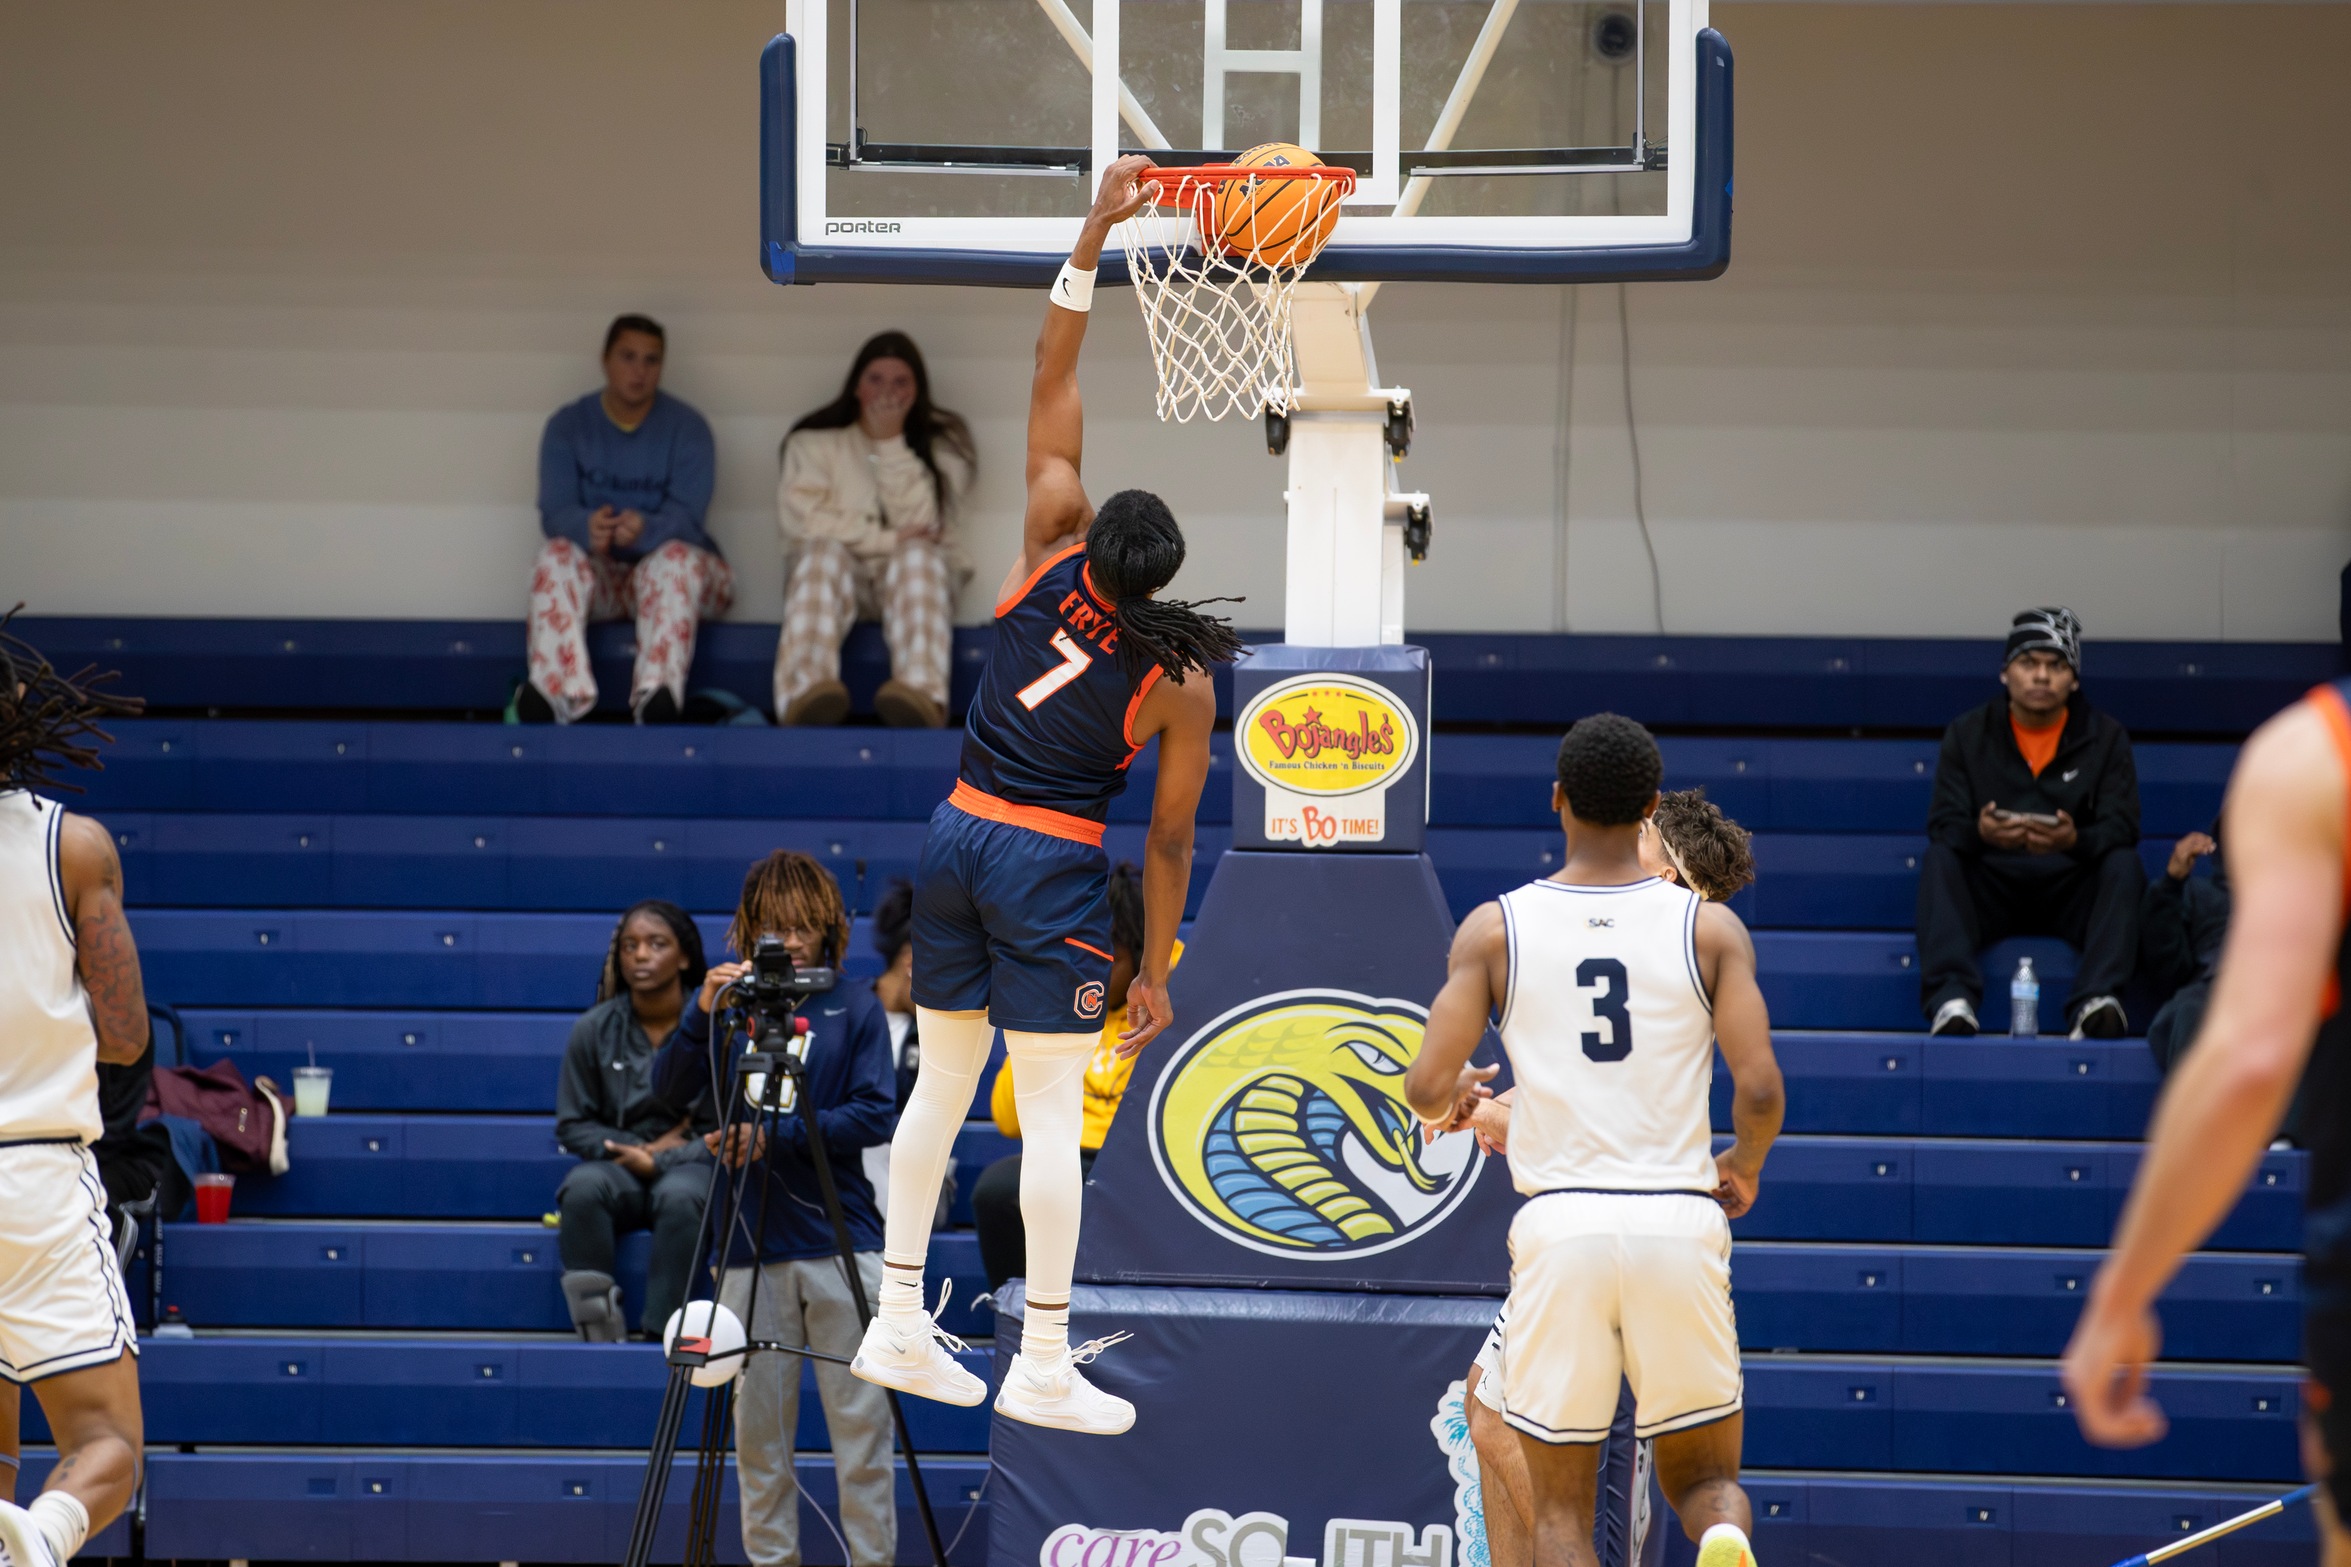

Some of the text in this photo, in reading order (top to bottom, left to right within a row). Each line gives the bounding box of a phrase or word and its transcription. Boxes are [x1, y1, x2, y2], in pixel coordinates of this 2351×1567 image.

[825, 220, 901, 236] porter
[1015, 627, 1093, 712] 7
[1269, 760, 1301, 769] Famous
[1303, 760, 1338, 770] Chicken
[1351, 760, 1385, 770] Biscuits
[1272, 818, 1298, 834] IT'S
[1341, 818, 1379, 836] TIME!
[1588, 918, 1615, 928] SAC
[1576, 958, 1633, 1063] 3
